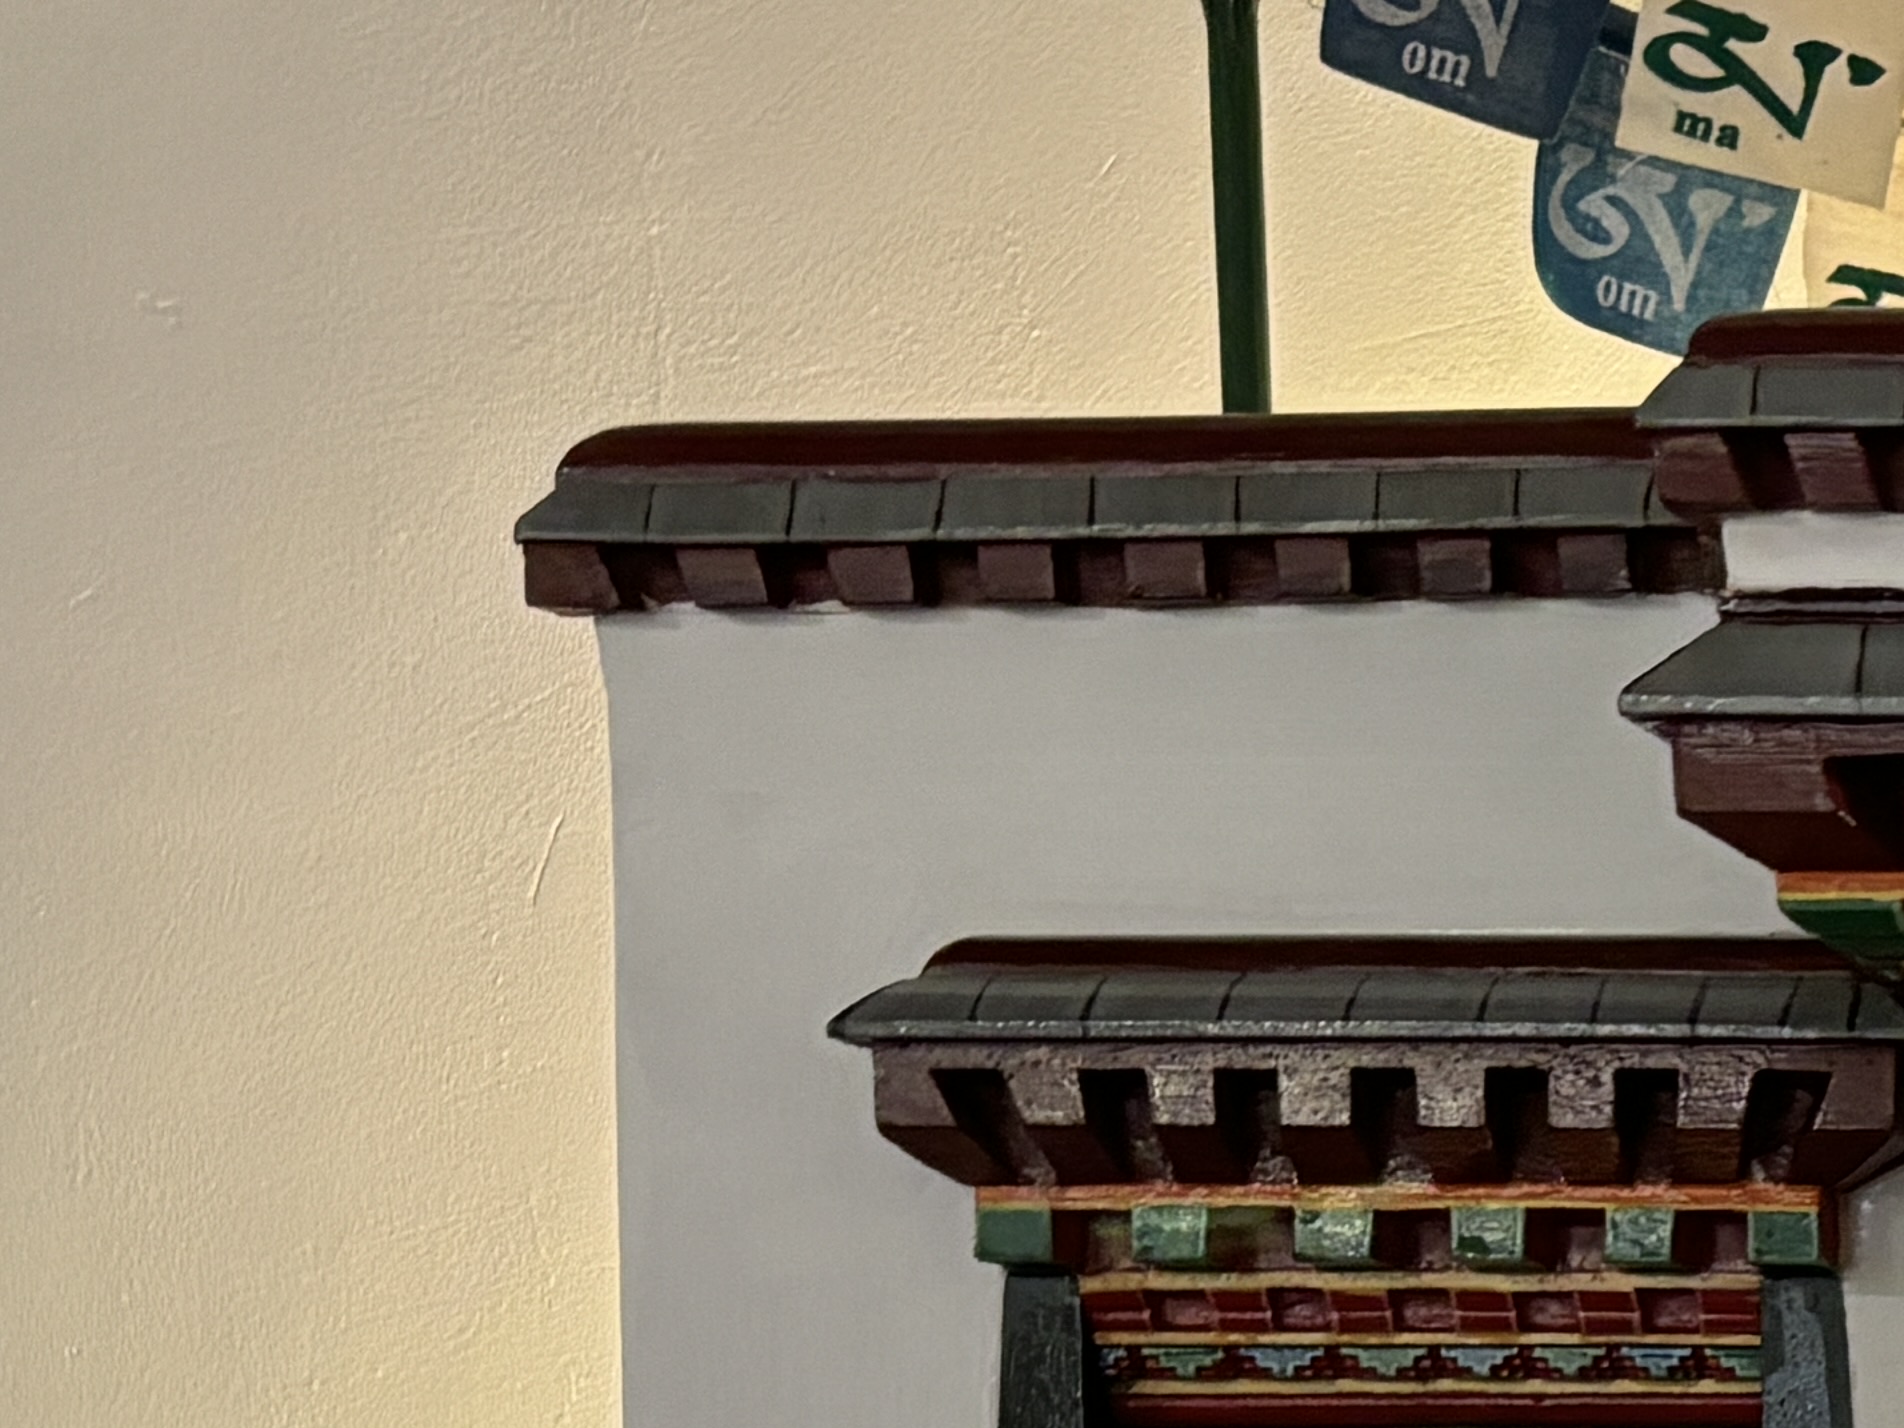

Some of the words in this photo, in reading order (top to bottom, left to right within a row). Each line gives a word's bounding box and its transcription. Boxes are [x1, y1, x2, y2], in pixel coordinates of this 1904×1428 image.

[1402, 40, 1471, 88] om
[1672, 108, 1740, 150] ma
[1596, 274, 1660, 321] om
